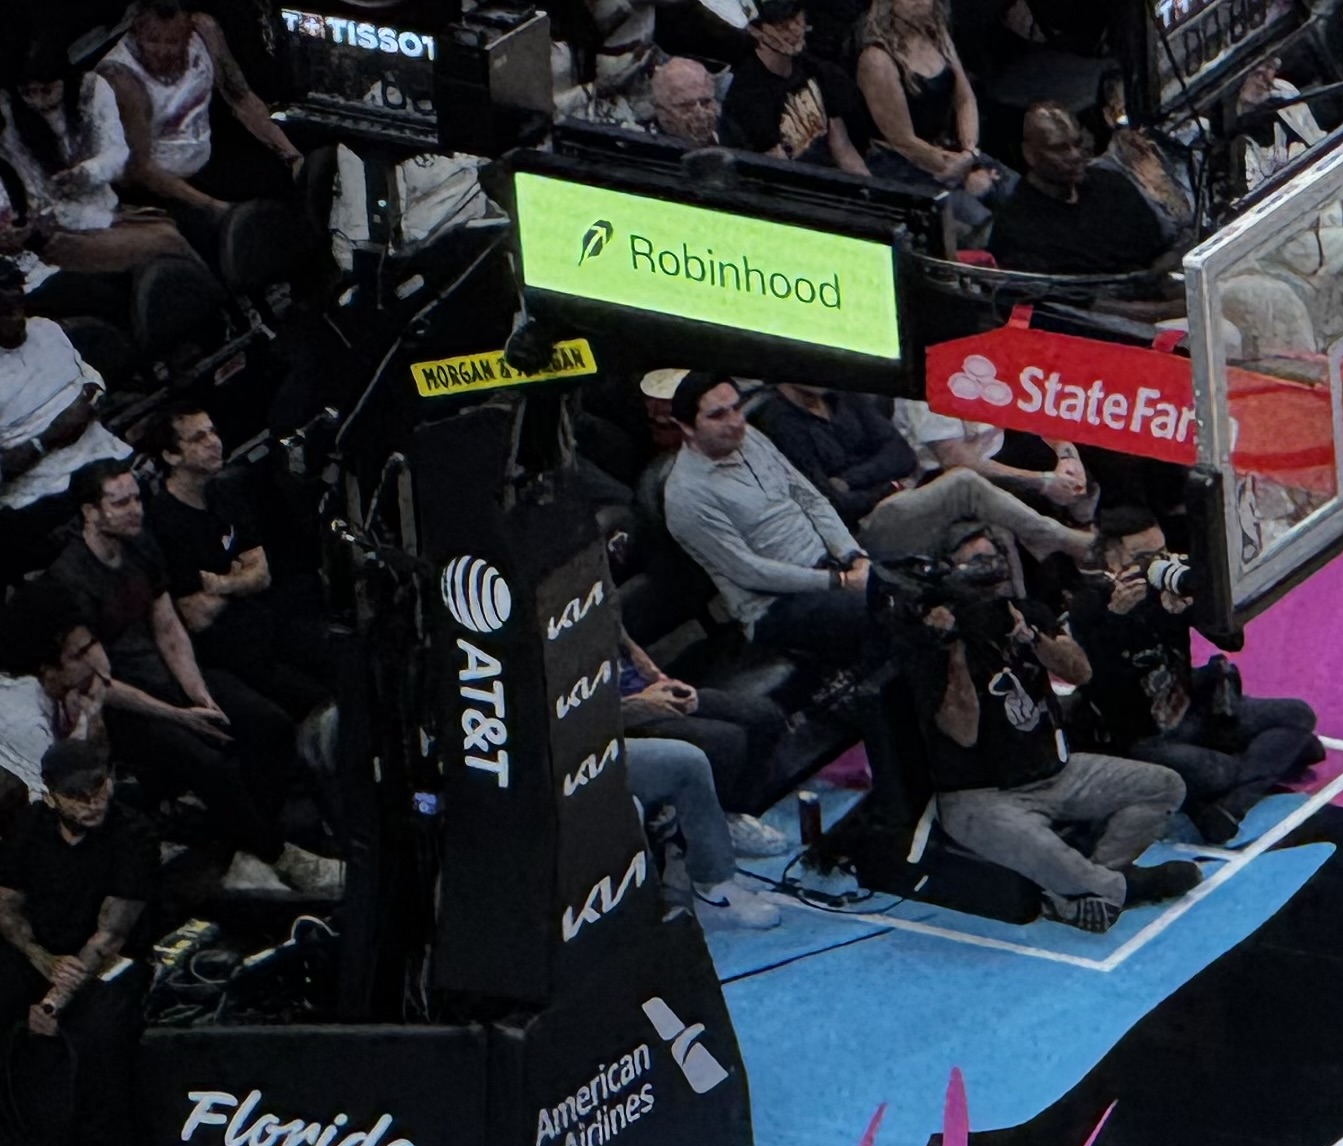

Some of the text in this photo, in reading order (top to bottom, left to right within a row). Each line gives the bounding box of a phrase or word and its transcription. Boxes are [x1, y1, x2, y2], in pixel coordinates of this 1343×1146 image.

[629, 233, 842, 311] Robinhood
[421, 359, 497, 391] MORGAN
[1016, 364, 1207, 444] StateFar
[547, 580, 604, 641] KIA
[456, 638, 509, 789] AT&T
[556, 660, 612, 720] KIA
[563, 738, 619, 797] KIA
[562, 850, 647, 943] KIA
